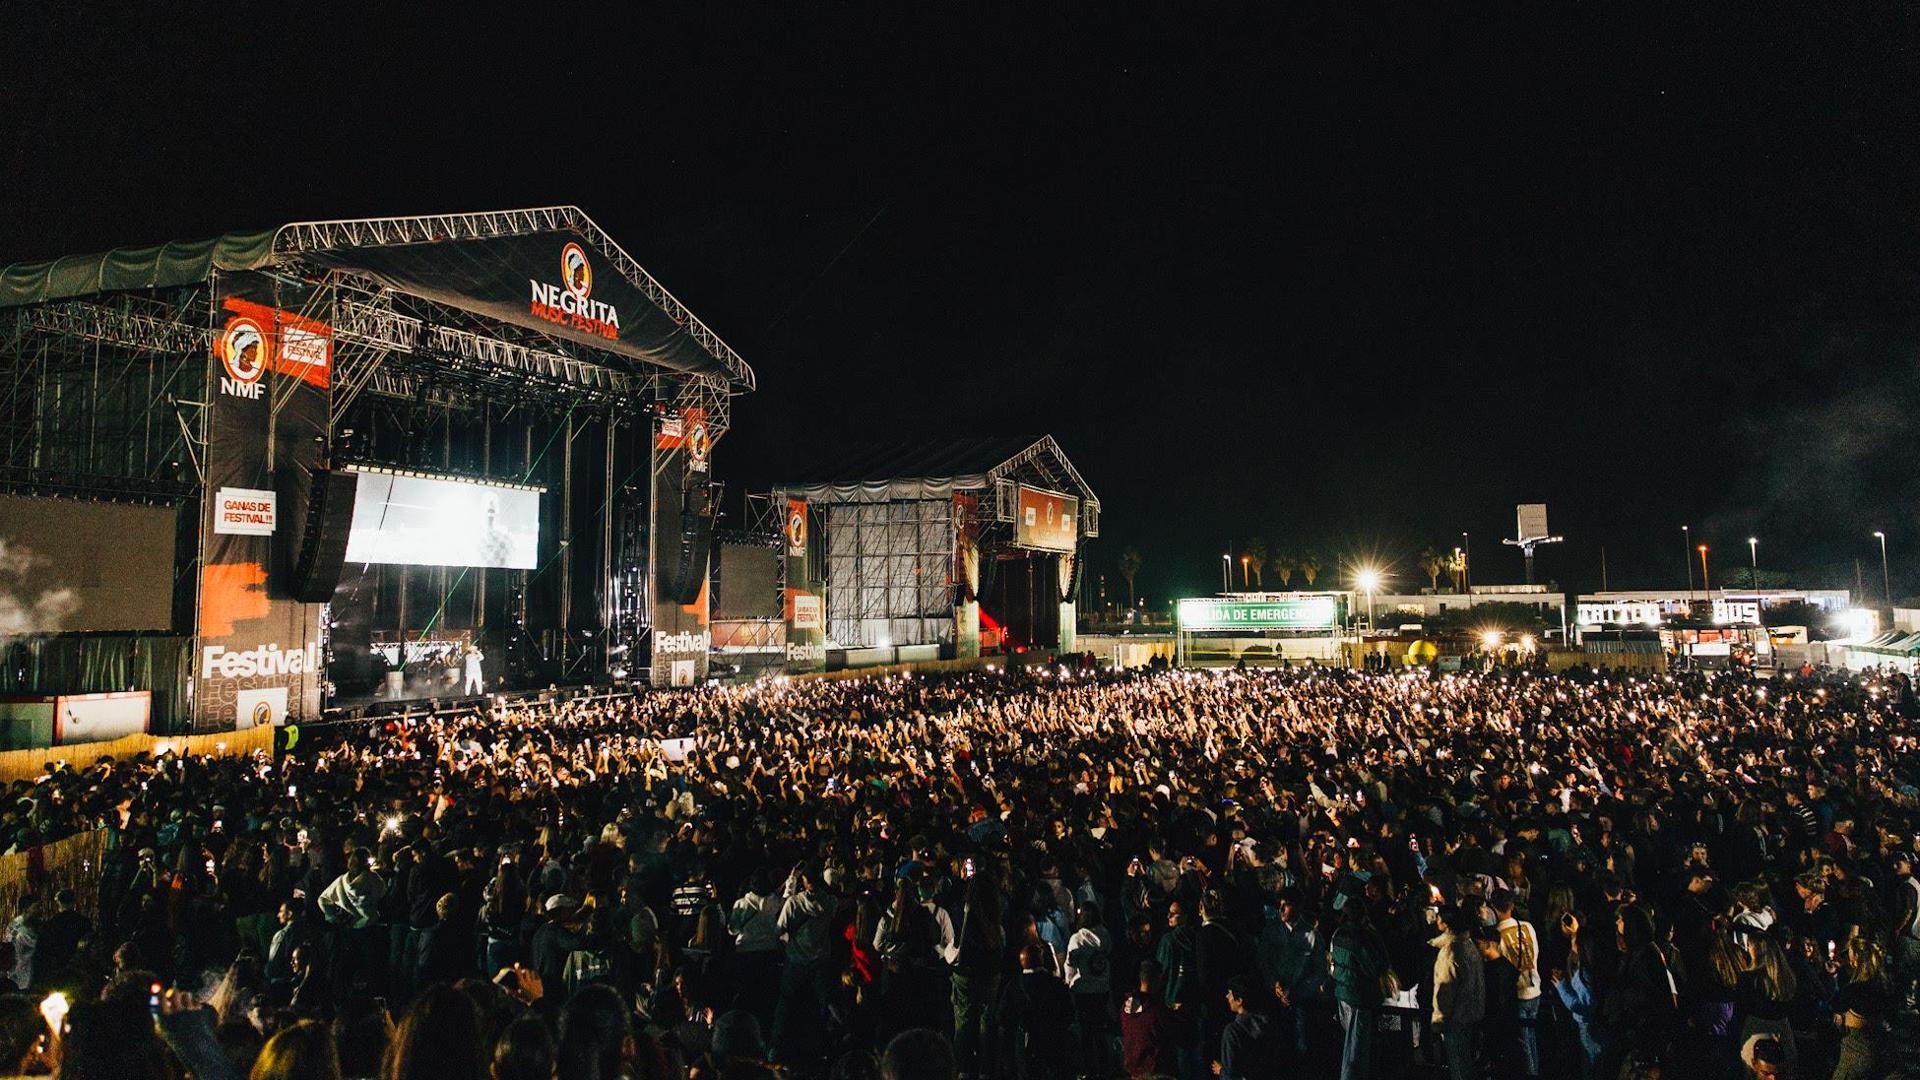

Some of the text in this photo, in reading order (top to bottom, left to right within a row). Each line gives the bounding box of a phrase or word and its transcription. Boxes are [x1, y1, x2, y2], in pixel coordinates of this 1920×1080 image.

[530, 279, 620, 329] NEGRITA
[531, 300, 620, 340] MUSIC FESTIVAL
[220, 377, 266, 400] NMF
[224, 500, 271, 513] GANAS DE
[1234, 609, 1248, 621] DE
[1713, 603, 1760, 624] BUS
[655, 630, 711, 654] Festival
[202, 642, 315, 679] Festival
